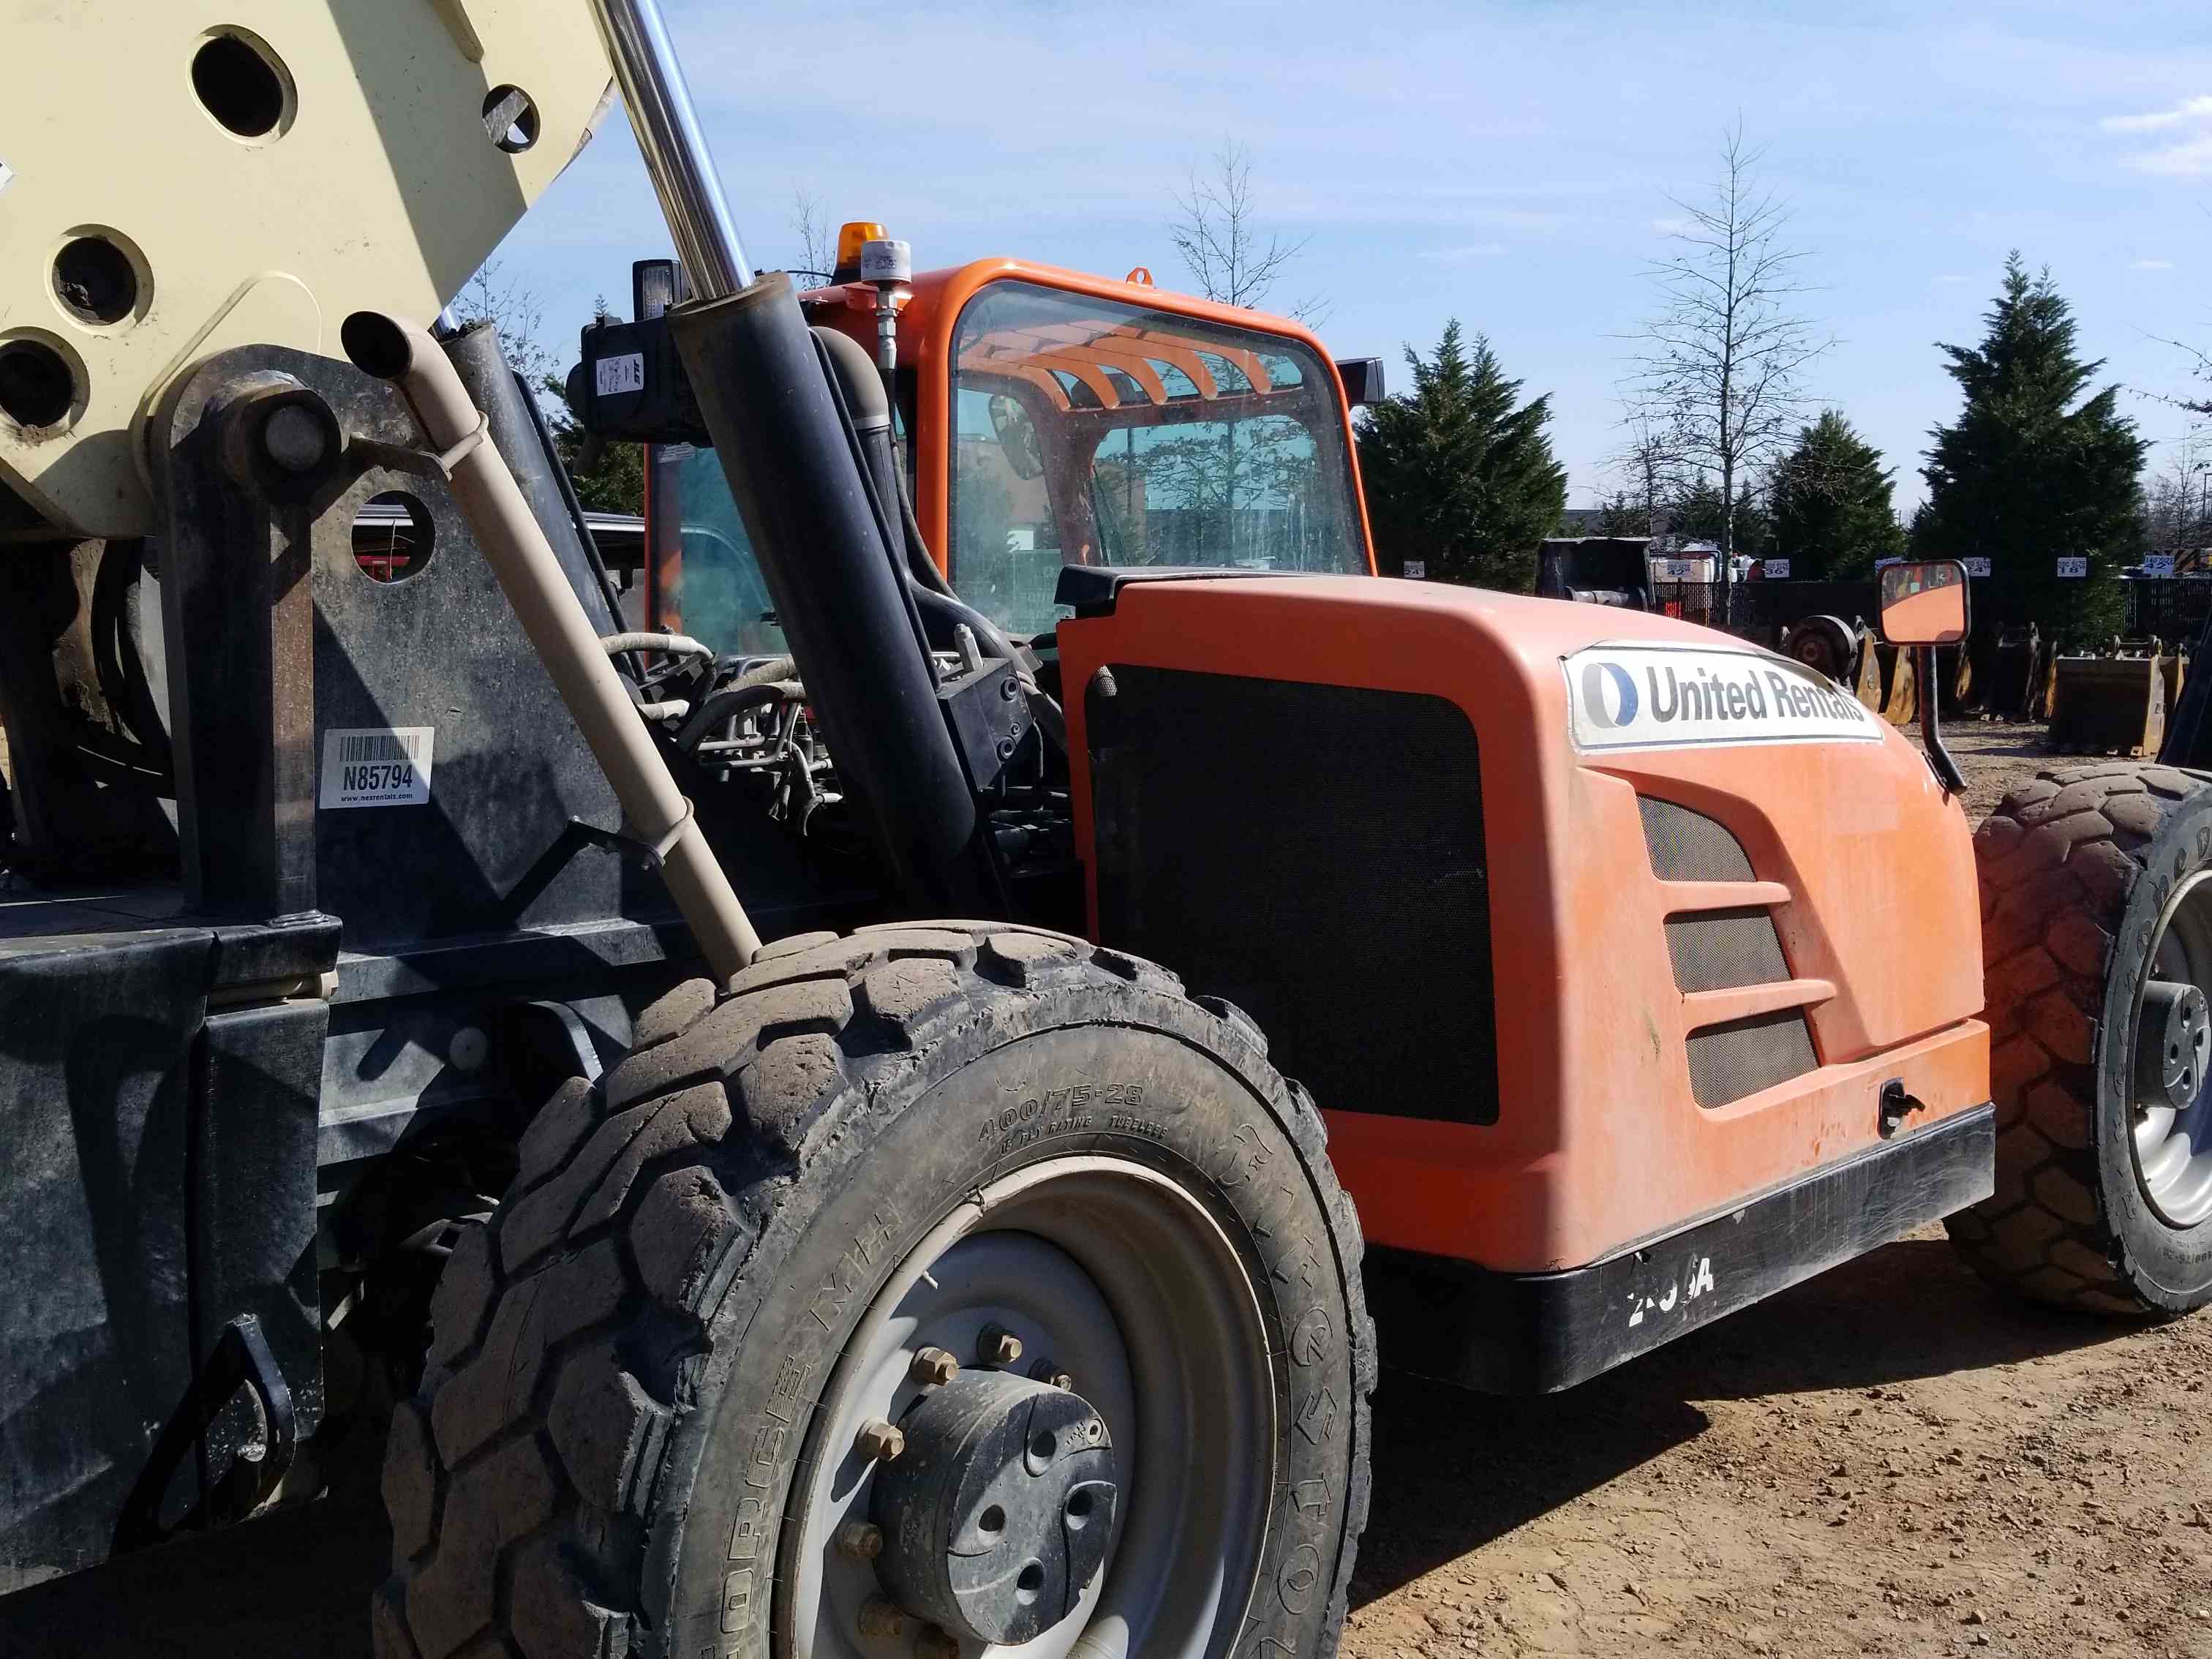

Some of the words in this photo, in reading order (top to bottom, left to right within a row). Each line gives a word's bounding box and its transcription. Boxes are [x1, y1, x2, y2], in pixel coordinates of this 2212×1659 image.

[1646, 666, 1768, 723] United
[1764, 670, 1865, 722] Rentals
[341, 793, 414, 802] www.nesrentals.com
[343, 764, 413, 791] N85794
[978, 1083, 1144, 1143] 400/75-28
